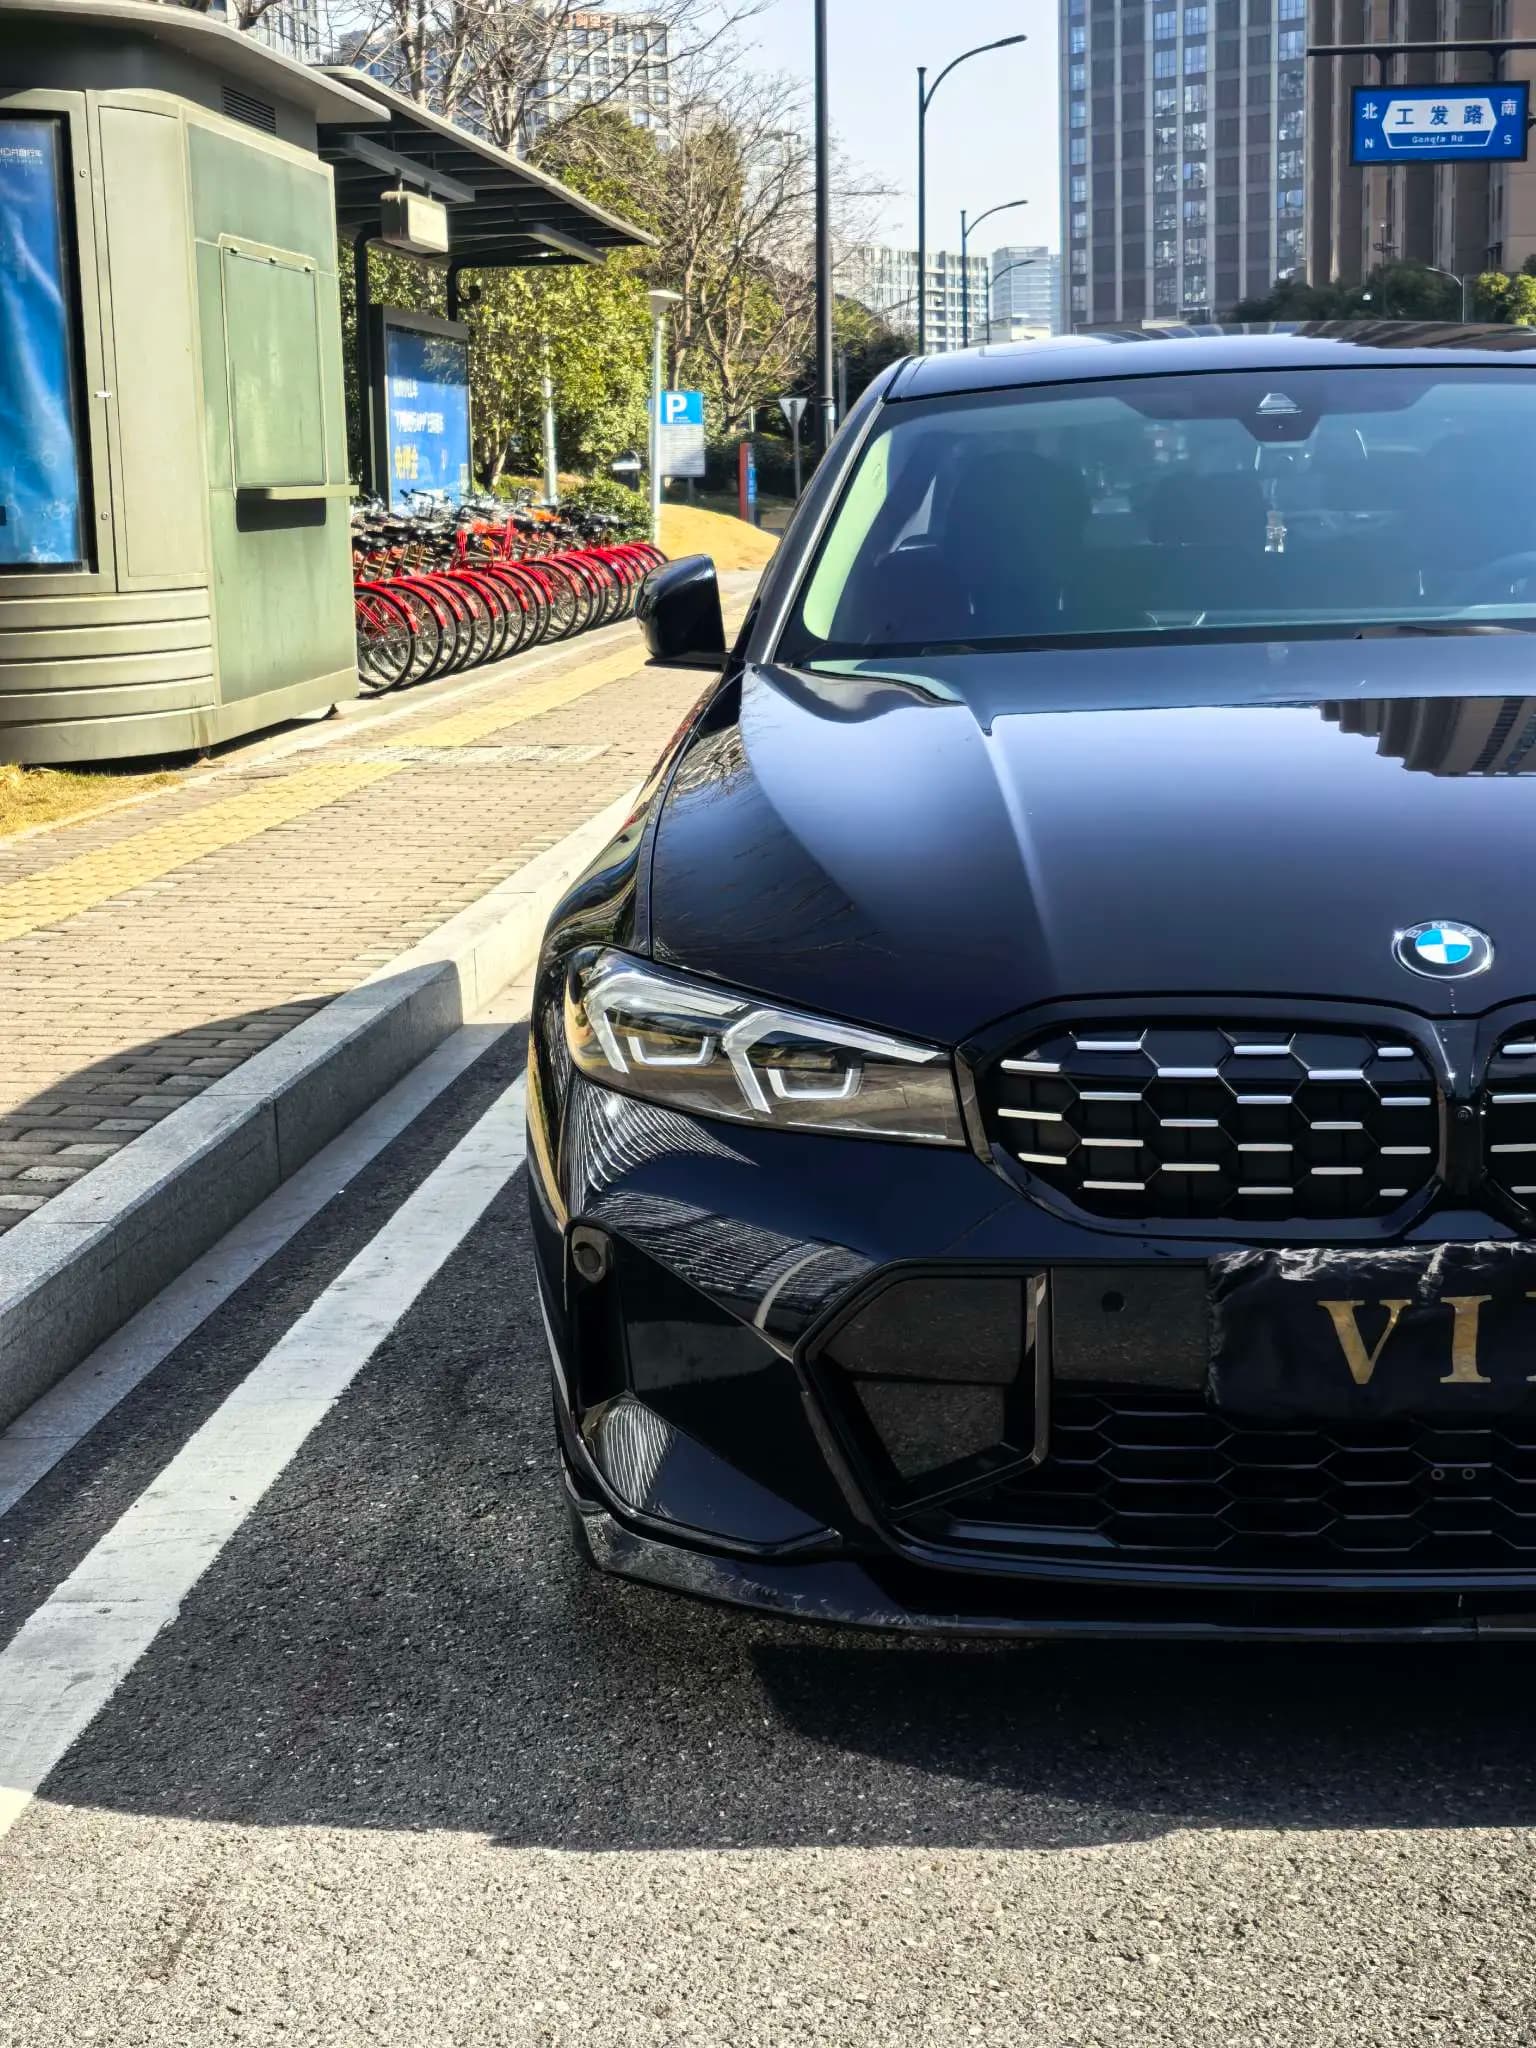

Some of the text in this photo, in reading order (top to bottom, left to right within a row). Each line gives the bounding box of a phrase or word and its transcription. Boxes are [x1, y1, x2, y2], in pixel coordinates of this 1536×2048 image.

[1362, 102, 1378, 120] 北
[1395, 105, 1484, 126] 工发路
[1501, 99, 1518, 116] 南
[1365, 138, 1374, 149] N
[1504, 135, 1512, 145] S
[666, 394, 687, 423] P
[1406, 920, 1480, 938] BMW
[1317, 1295, 1536, 1384] VI
